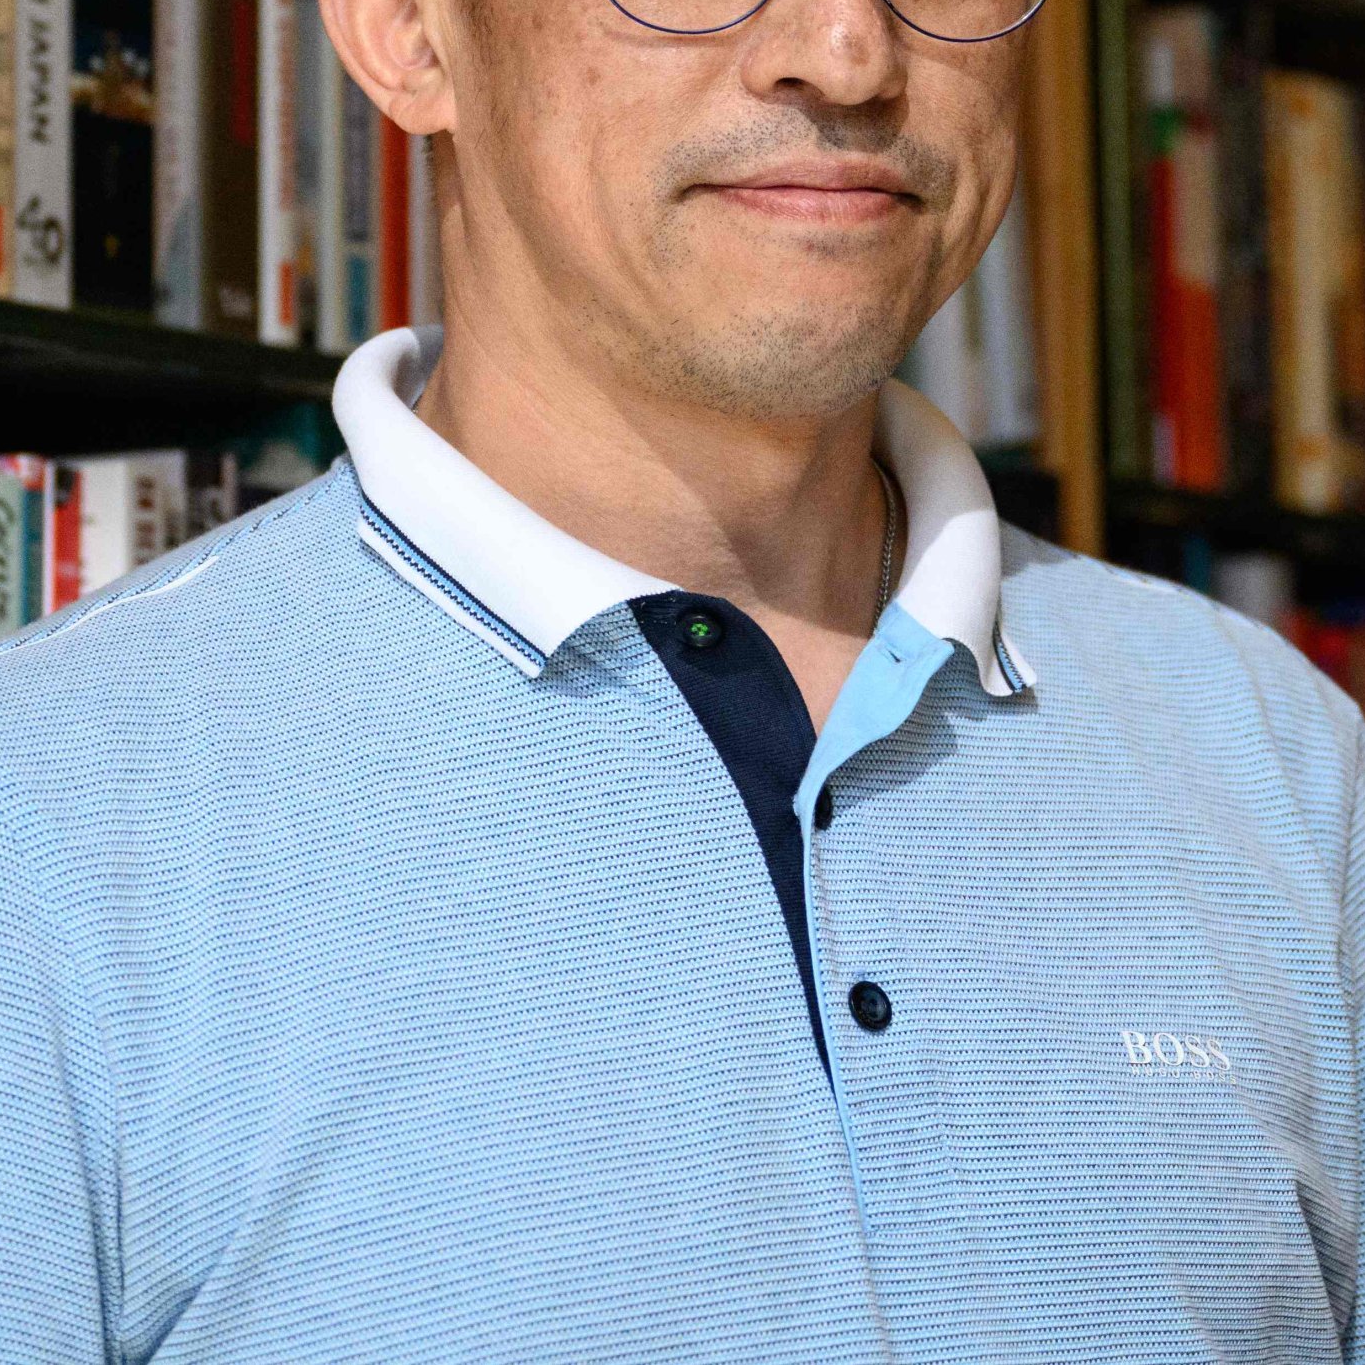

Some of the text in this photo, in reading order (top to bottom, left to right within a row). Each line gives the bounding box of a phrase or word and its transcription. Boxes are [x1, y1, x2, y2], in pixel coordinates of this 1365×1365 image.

[1121, 1030, 1231, 1071] BOSS
[1131, 1067, 1237, 1084] HUGO BOSS
